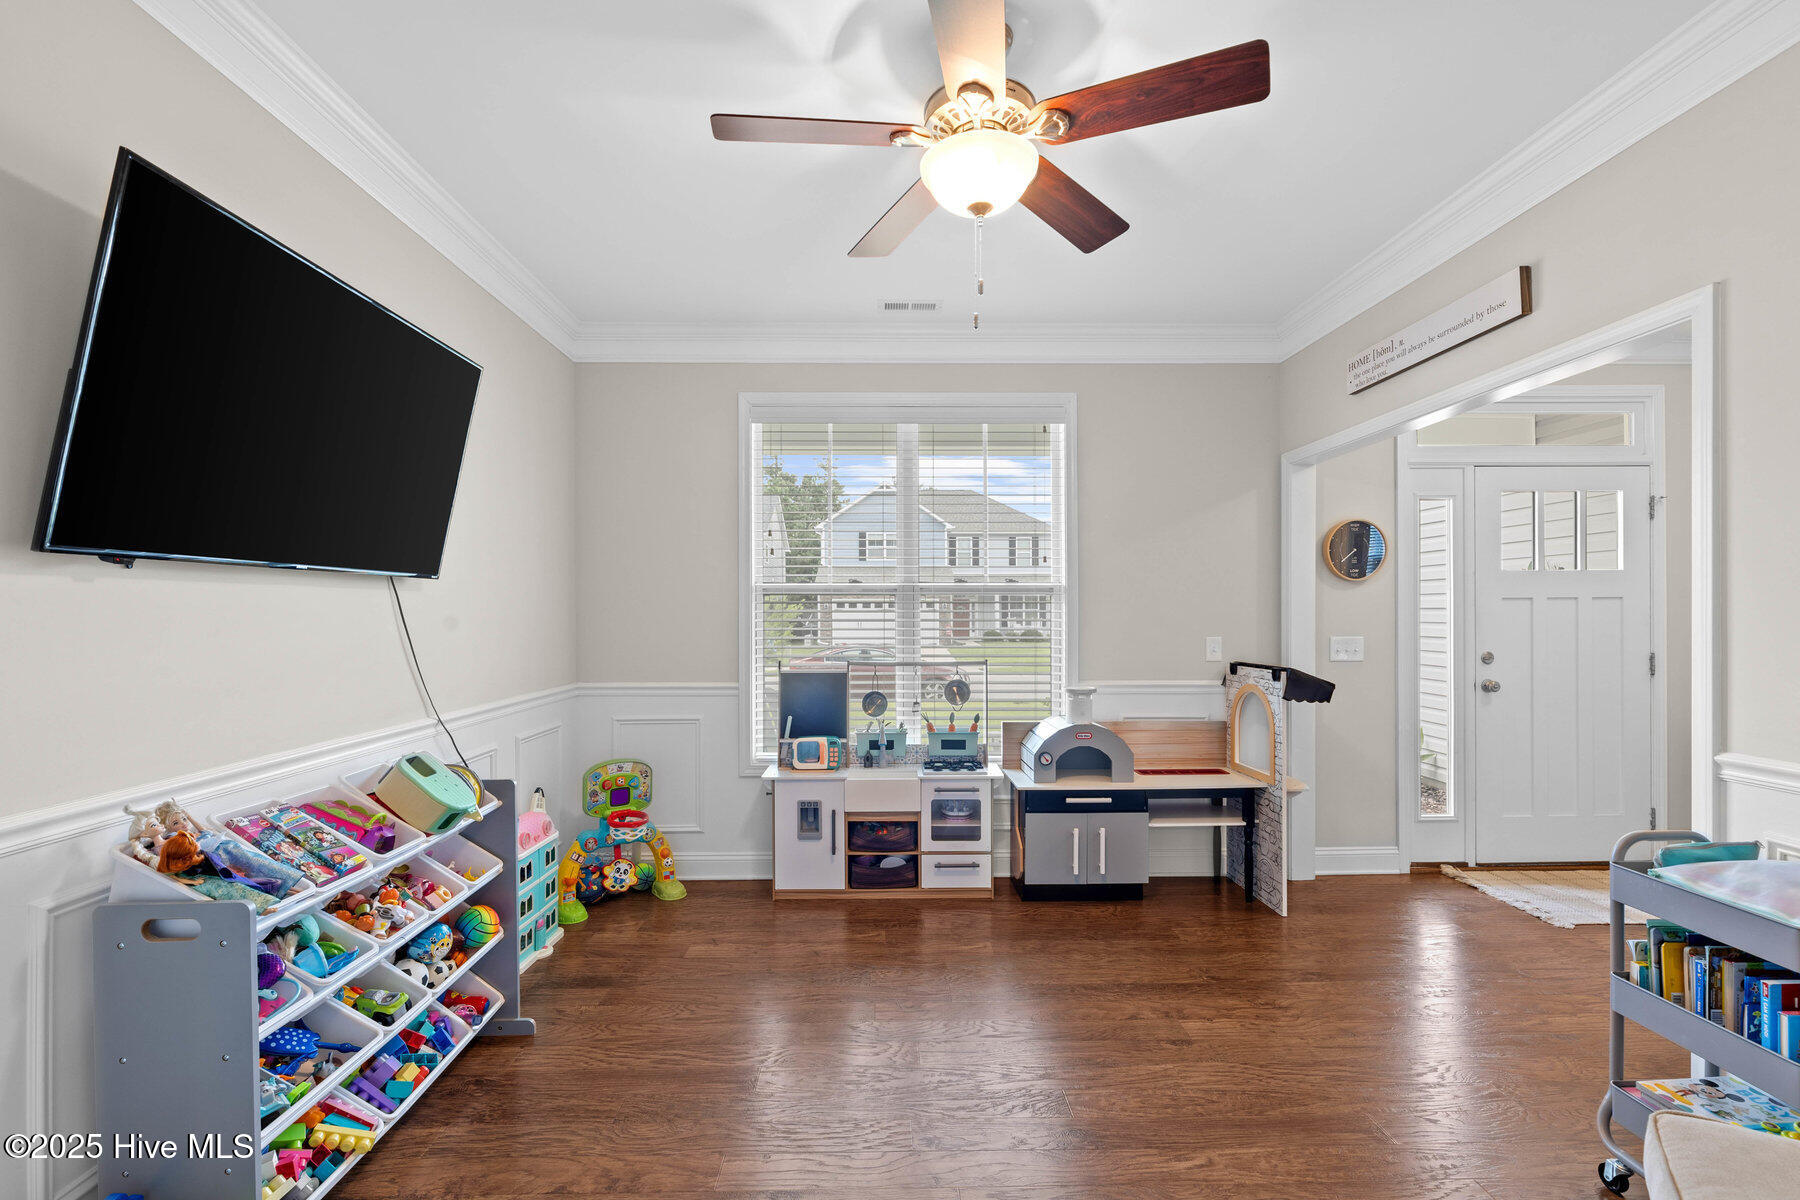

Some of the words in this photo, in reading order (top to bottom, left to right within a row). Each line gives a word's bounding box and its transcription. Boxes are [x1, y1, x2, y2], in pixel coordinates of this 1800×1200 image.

[1361, 368, 1370, 376] one
[1371, 361, 1384, 374] place
[1384, 357, 1396, 367] you
[1396, 348, 1407, 359] will
[1407, 340, 1427, 353] always
[1428, 334, 1436, 343] be
[1436, 313, 1475, 340] surrounded
[1475, 311, 1484, 321] by
[1486, 299, 1507, 315] those
[1348, 353, 1371, 372] HOME
